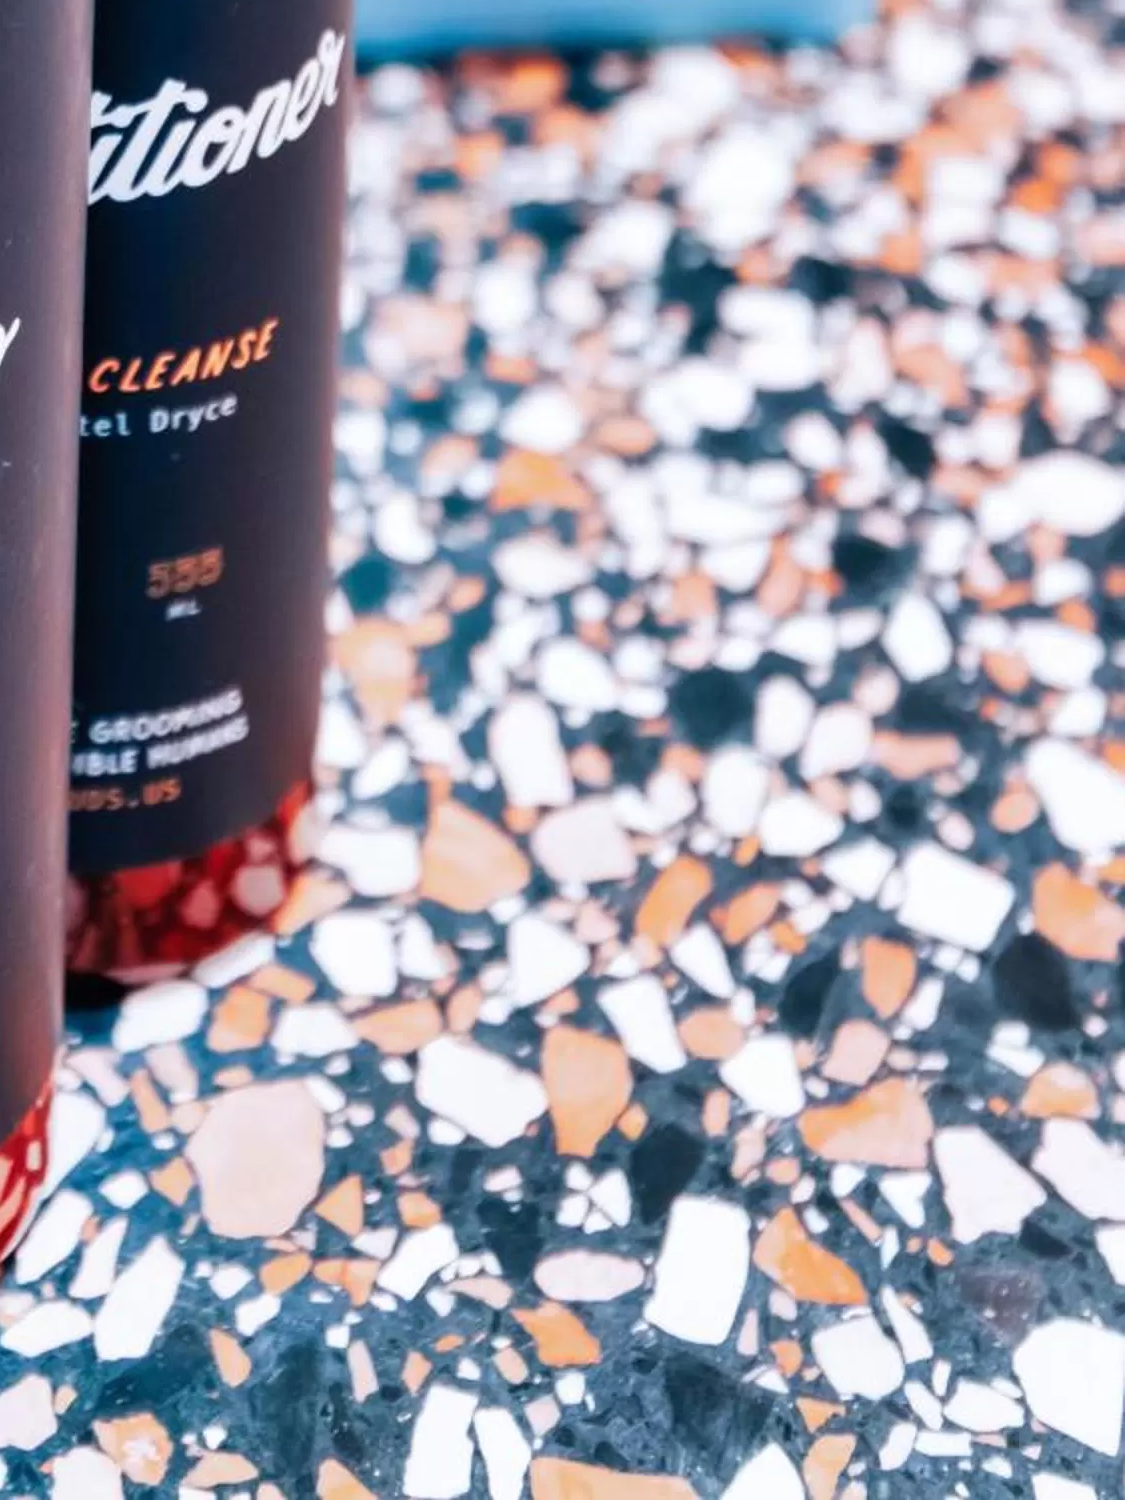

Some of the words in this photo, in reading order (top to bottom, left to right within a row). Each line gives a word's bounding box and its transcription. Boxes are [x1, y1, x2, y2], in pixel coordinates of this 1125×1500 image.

[89, 317, 278, 393] CLEANSE
[148, 393, 238, 434] Dryce
[89, 689, 244, 746] GROOMING
